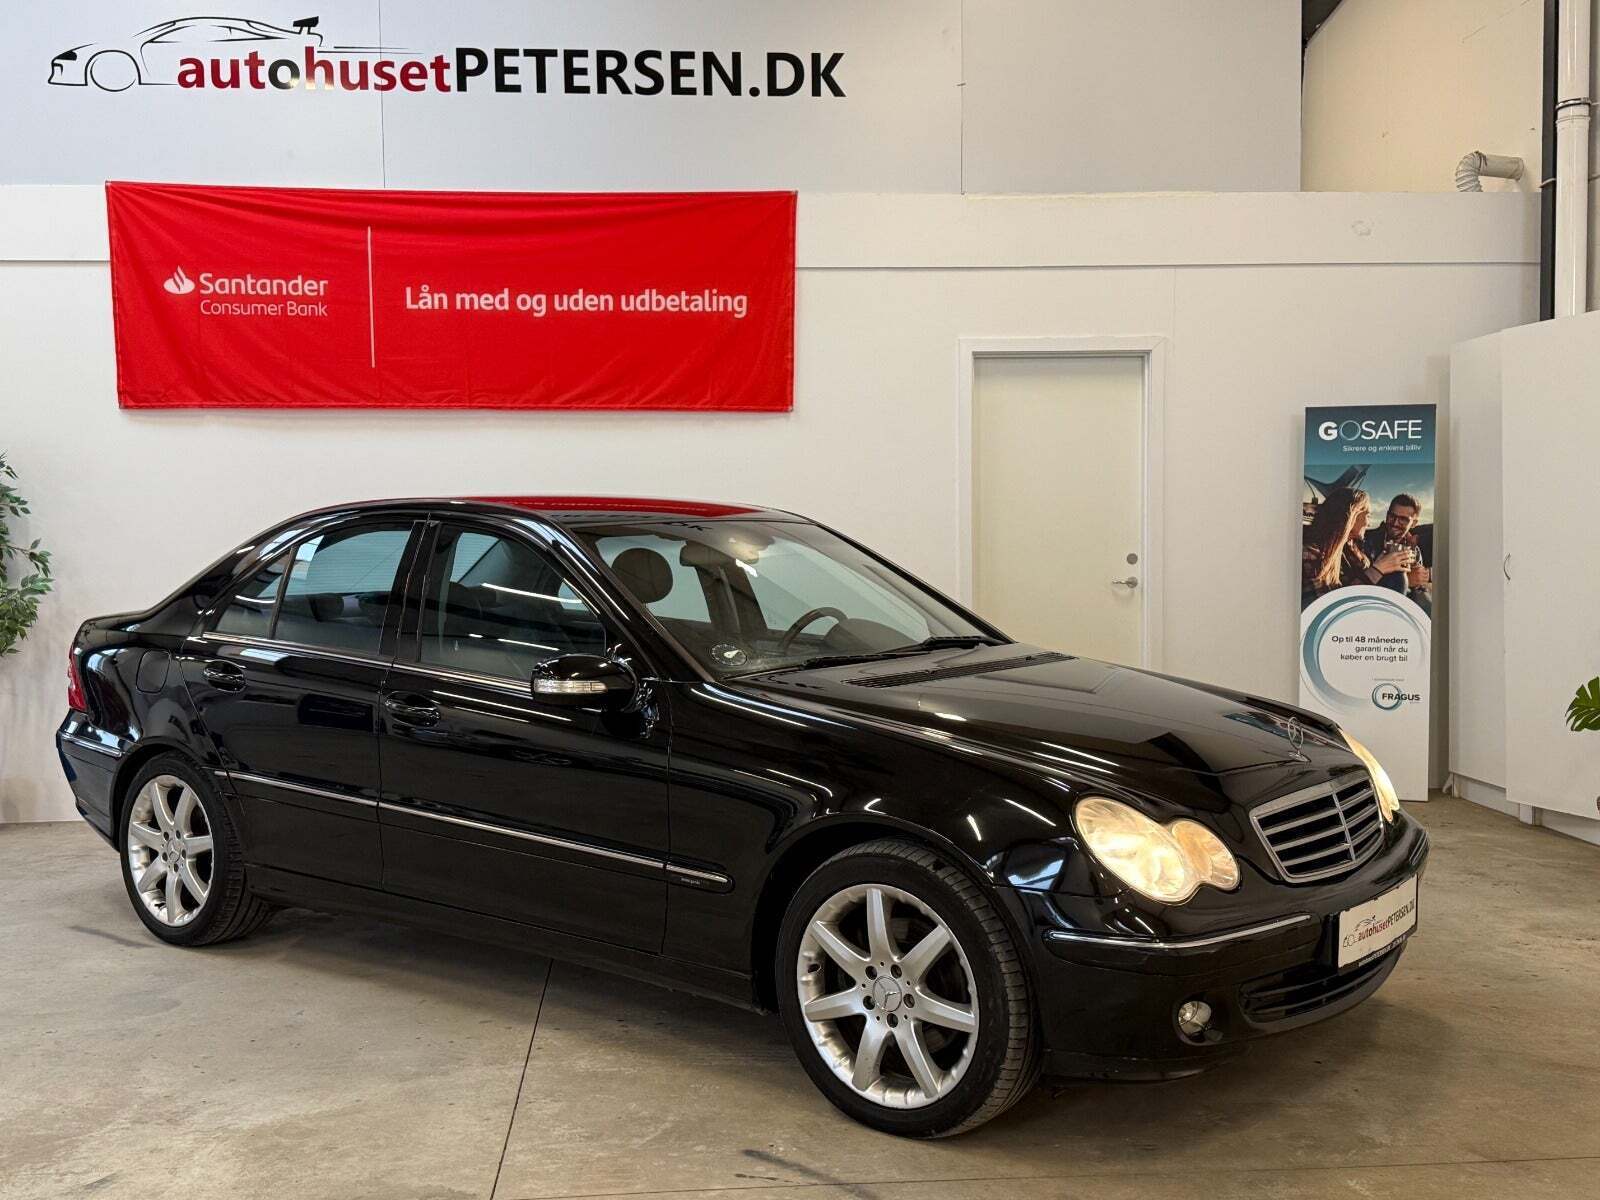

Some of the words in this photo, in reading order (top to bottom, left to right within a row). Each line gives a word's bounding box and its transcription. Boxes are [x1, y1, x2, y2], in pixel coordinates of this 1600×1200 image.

[177, 46, 847, 97] autohusetPETERSEN.DK
[200, 272, 328, 296] Santander
[200, 299, 284, 316] Consumer
[287, 301, 328, 317] Bank
[405, 284, 448, 310] Lån
[455, 288, 509, 311] med
[516, 292, 547, 317] og
[554, 288, 614, 312] uden
[620, 289, 748, 319] udbetaling
[1318, 419, 1423, 441] GOSAFE
[1331, 635, 1344, 644] Op
[1367, 635, 1408, 644] måneders
[1340, 653, 1362, 661] køber
[1376, 654, 1397, 663] brugt
[1355, 645, 1381, 654] garanti
[1383, 645, 1396, 653] når
[1381, 692, 1421, 701] FRAGUS
